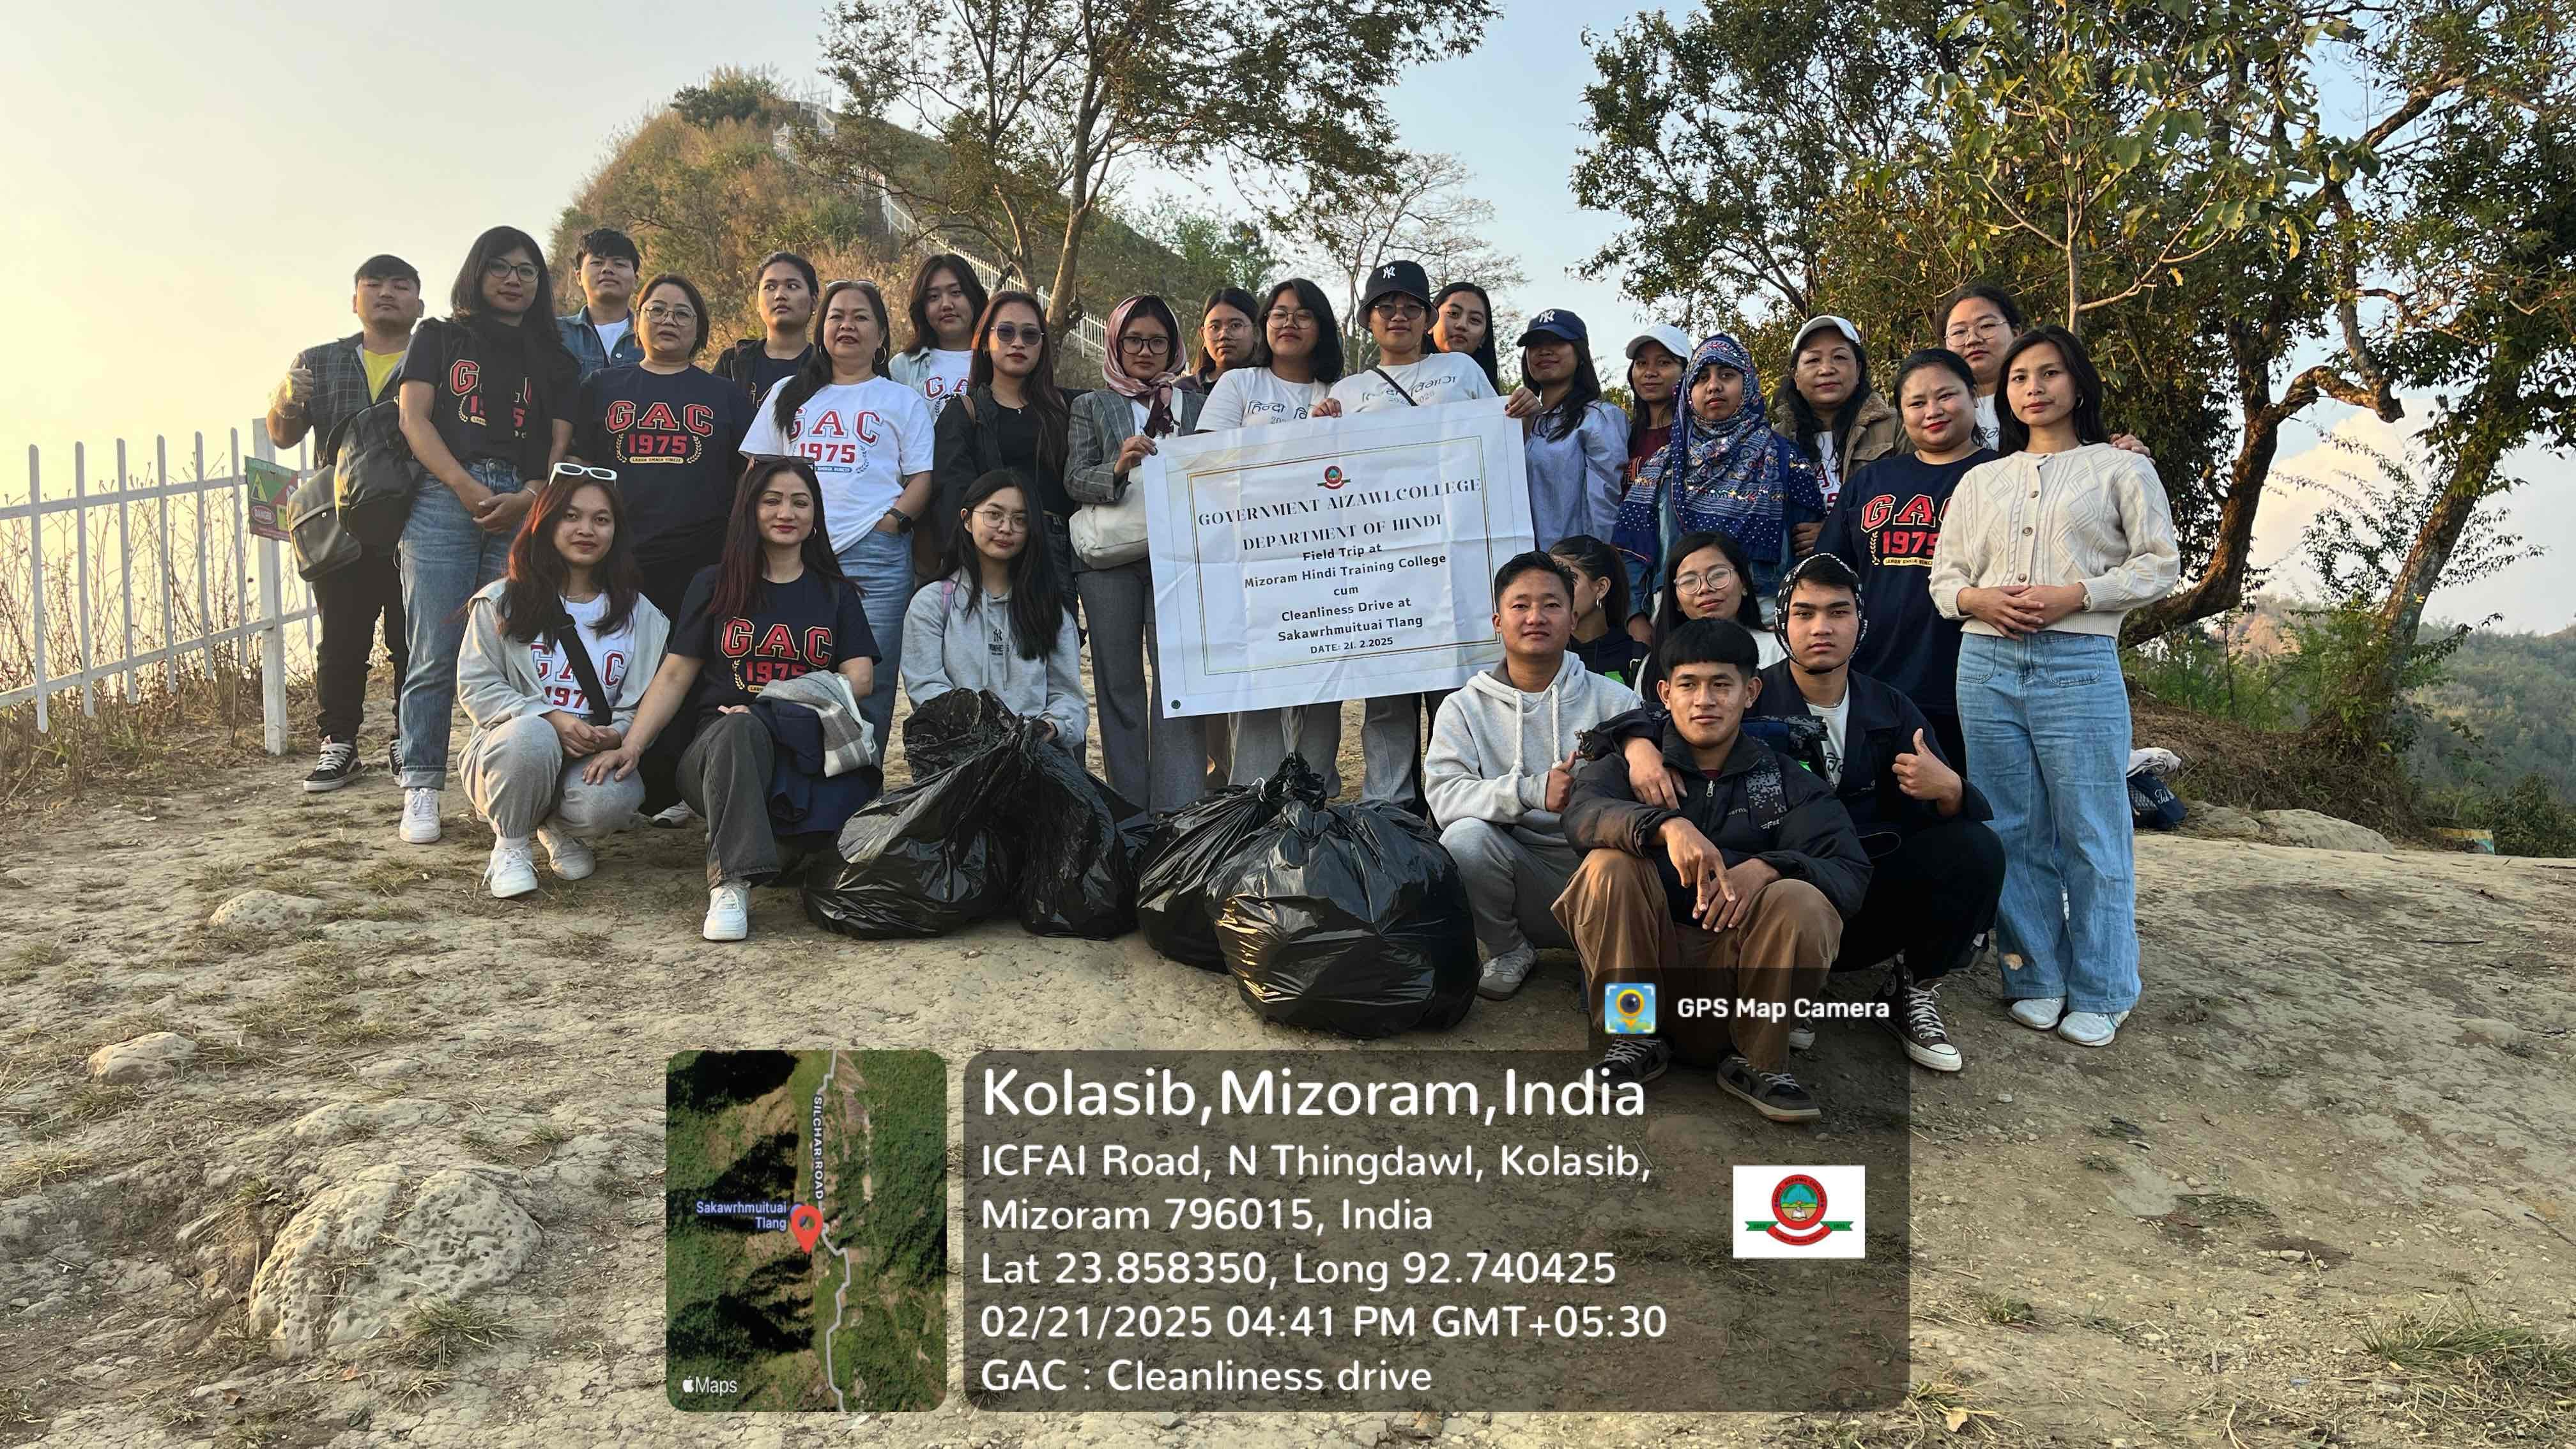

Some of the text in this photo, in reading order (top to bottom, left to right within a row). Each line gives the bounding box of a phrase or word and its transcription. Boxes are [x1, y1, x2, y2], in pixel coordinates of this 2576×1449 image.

[924, 375, 969, 401] GA
[606, 400, 714, 437] GAC
[629, 433, 688, 454] 1975
[1199, 499, 1319, 526] GOVERNMENT
[1860, 494, 1952, 533] GA
[1243, 514, 1441, 551] DEPARTMENT OF HINDI
[1303, 543, 1383, 561] Field Trip at
[1245, 555, 1446, 588] Mizoram Hindi Training College
[1333, 585, 1359, 596] cum
[1282, 597, 1411, 622] Cleanliness Drive at
[1278, 615, 1423, 641] Sakawrhmuituai Tlang
[721, 617, 832, 668] GAC
[1310, 643, 1340, 655] DATE:
[1360, 637, 1393, 649] 2.2025
